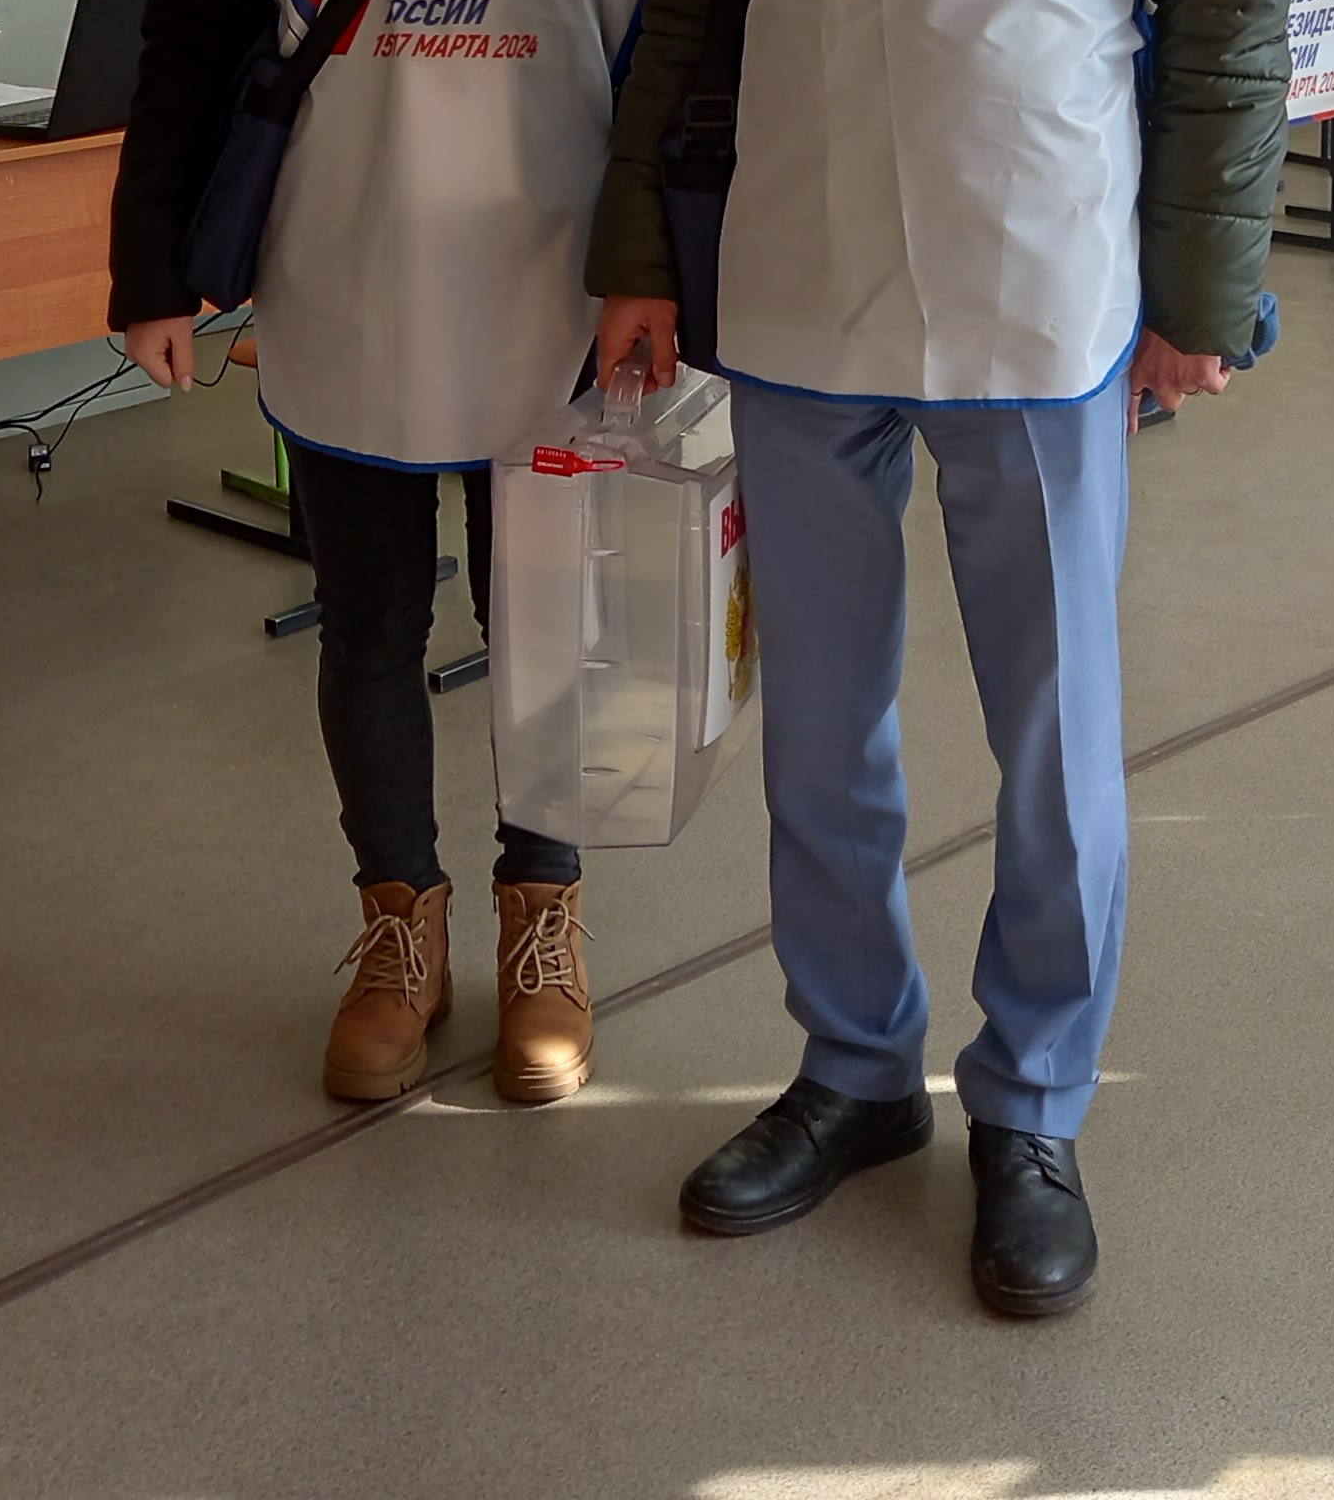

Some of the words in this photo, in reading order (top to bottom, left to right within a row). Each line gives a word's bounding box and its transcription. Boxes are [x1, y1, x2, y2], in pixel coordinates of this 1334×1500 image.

[408, 34, 491, 59] МАРТА
[492, 35, 538, 58] 2024
[1287, 74, 1318, 100] АРТА
